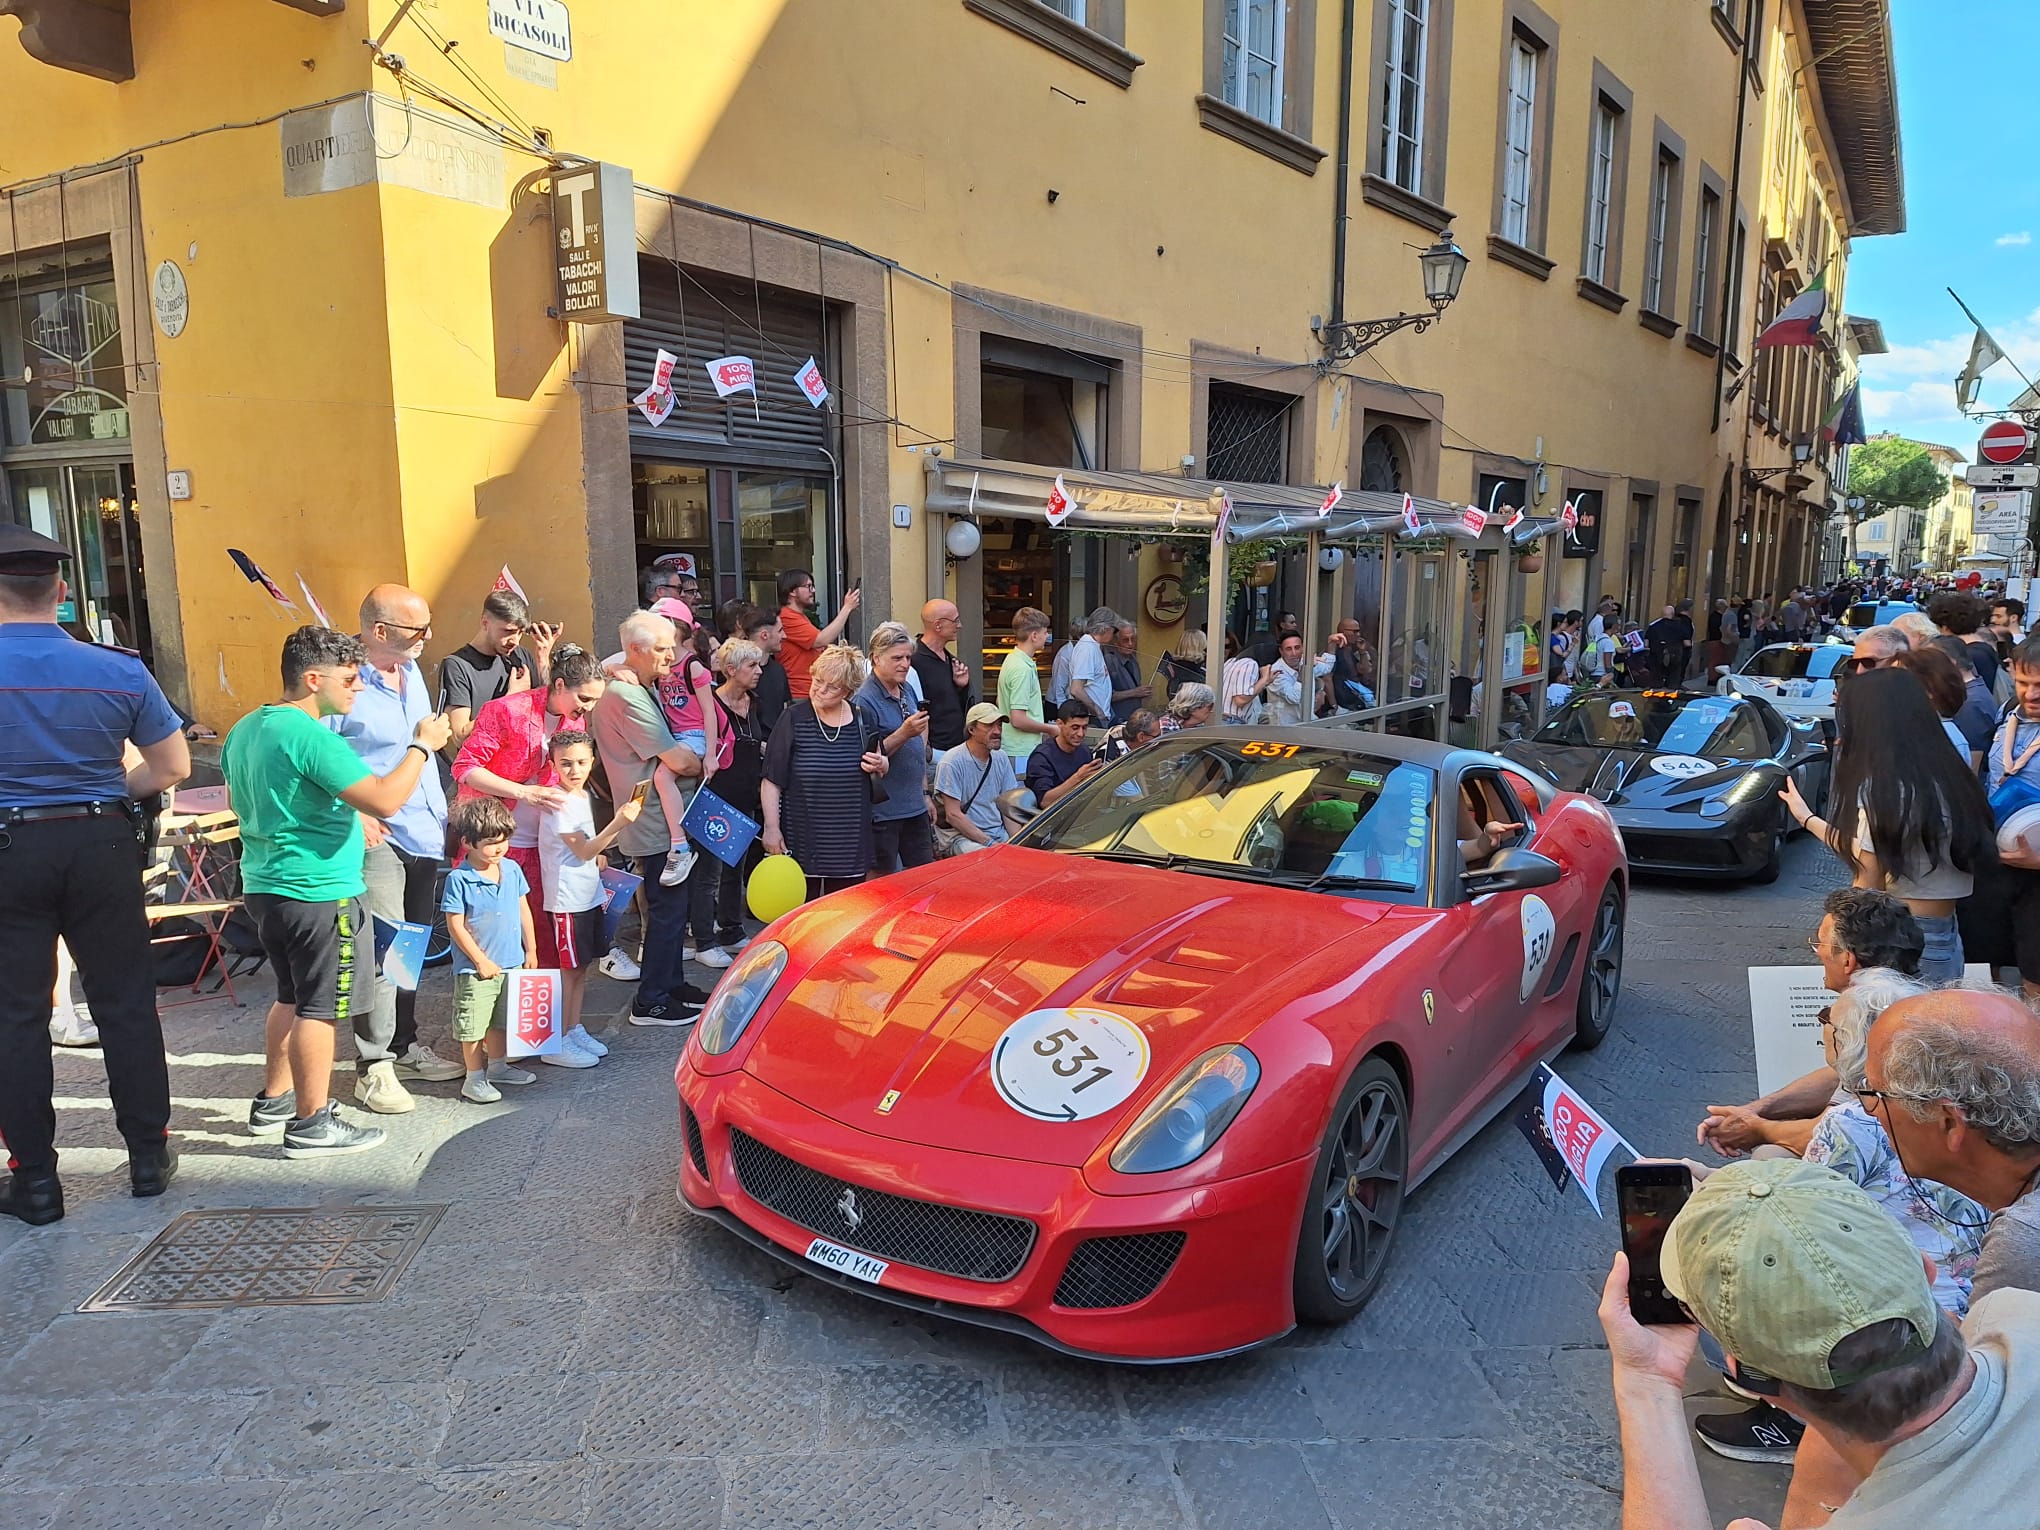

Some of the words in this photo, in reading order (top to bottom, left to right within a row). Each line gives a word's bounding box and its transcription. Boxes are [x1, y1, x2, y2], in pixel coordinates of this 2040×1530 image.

[515, 0, 545, 20] VIA
[493, 11, 567, 52] RICASOLI
[557, 172, 595, 249] T
[593, 233, 599, 244] 3
[569, 252, 585, 263] SALI
[586, 250, 591, 260] E
[559, 260, 602, 281] TABACCHI
[566, 279, 597, 296] VALORI
[565, 294, 600, 312] BOLLATI
[63, 393, 100, 416] TABACCHI
[46, 417, 75, 439] VALORI
[174, 474, 181, 490] 2
[1240, 741, 1301, 759] 531
[1661, 761, 1706, 774] 544
[1528, 928, 1550, 972] 531
[520, 977, 534, 1033] MIGLIA
[536, 982, 550, 1029] 1000
[1033, 1028, 1113, 1095] 531
[808, 1240, 850, 1267] WM60
[852, 1256, 884, 1281] YAH
